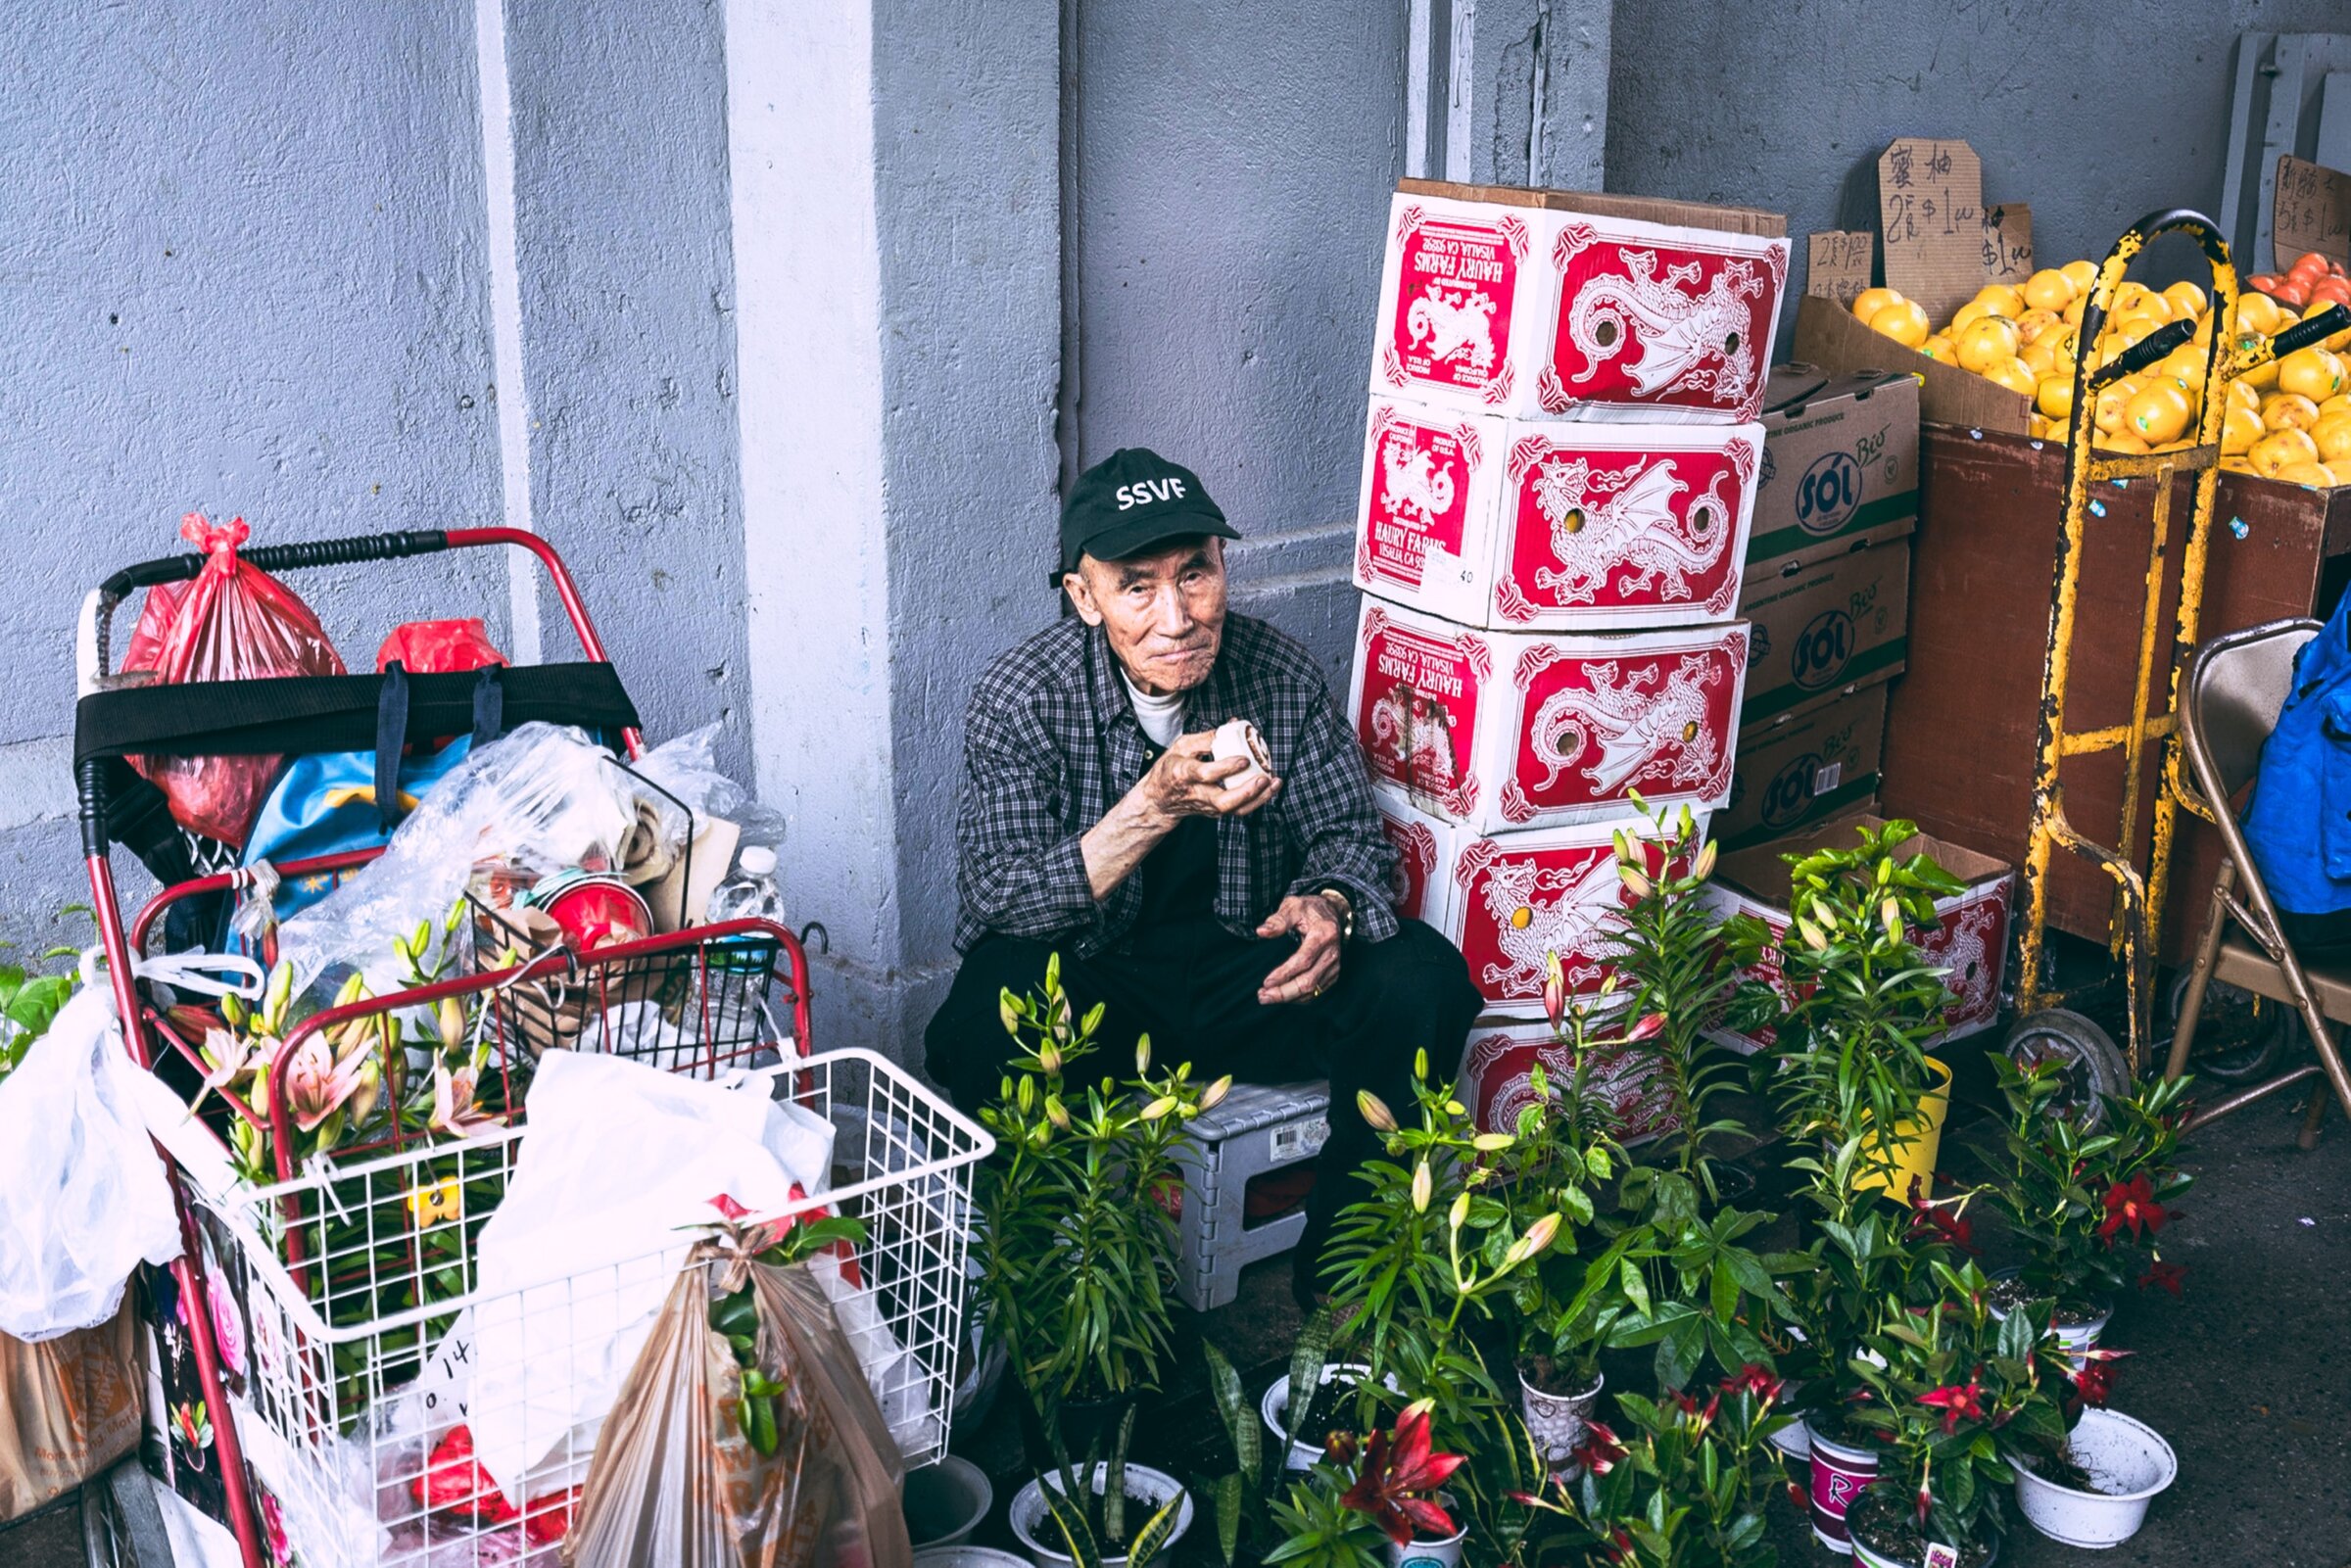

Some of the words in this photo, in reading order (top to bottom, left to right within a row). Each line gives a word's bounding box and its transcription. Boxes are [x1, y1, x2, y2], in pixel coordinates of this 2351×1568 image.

[1886, 194, 1904, 244] 2
[1447, 241, 1460, 256] CA
[1817, 236, 1830, 266] 2
[1414, 251, 1457, 276] FARMS
[1456, 257, 1504, 283] HAURY
[1783, 422, 1814, 436] ORGANIC
[1814, 411, 1846, 428] PRODUCE
[1116, 478, 1186, 510] SSVF
[1374, 520, 1410, 548] HAURY
[1404, 551, 1415, 567] CA
[1779, 584, 1807, 599] ORGANIC
[1378, 653, 1416, 684] FARMS
[1408, 649, 1419, 664] CA
[1415, 667, 1463, 699] HAURY
